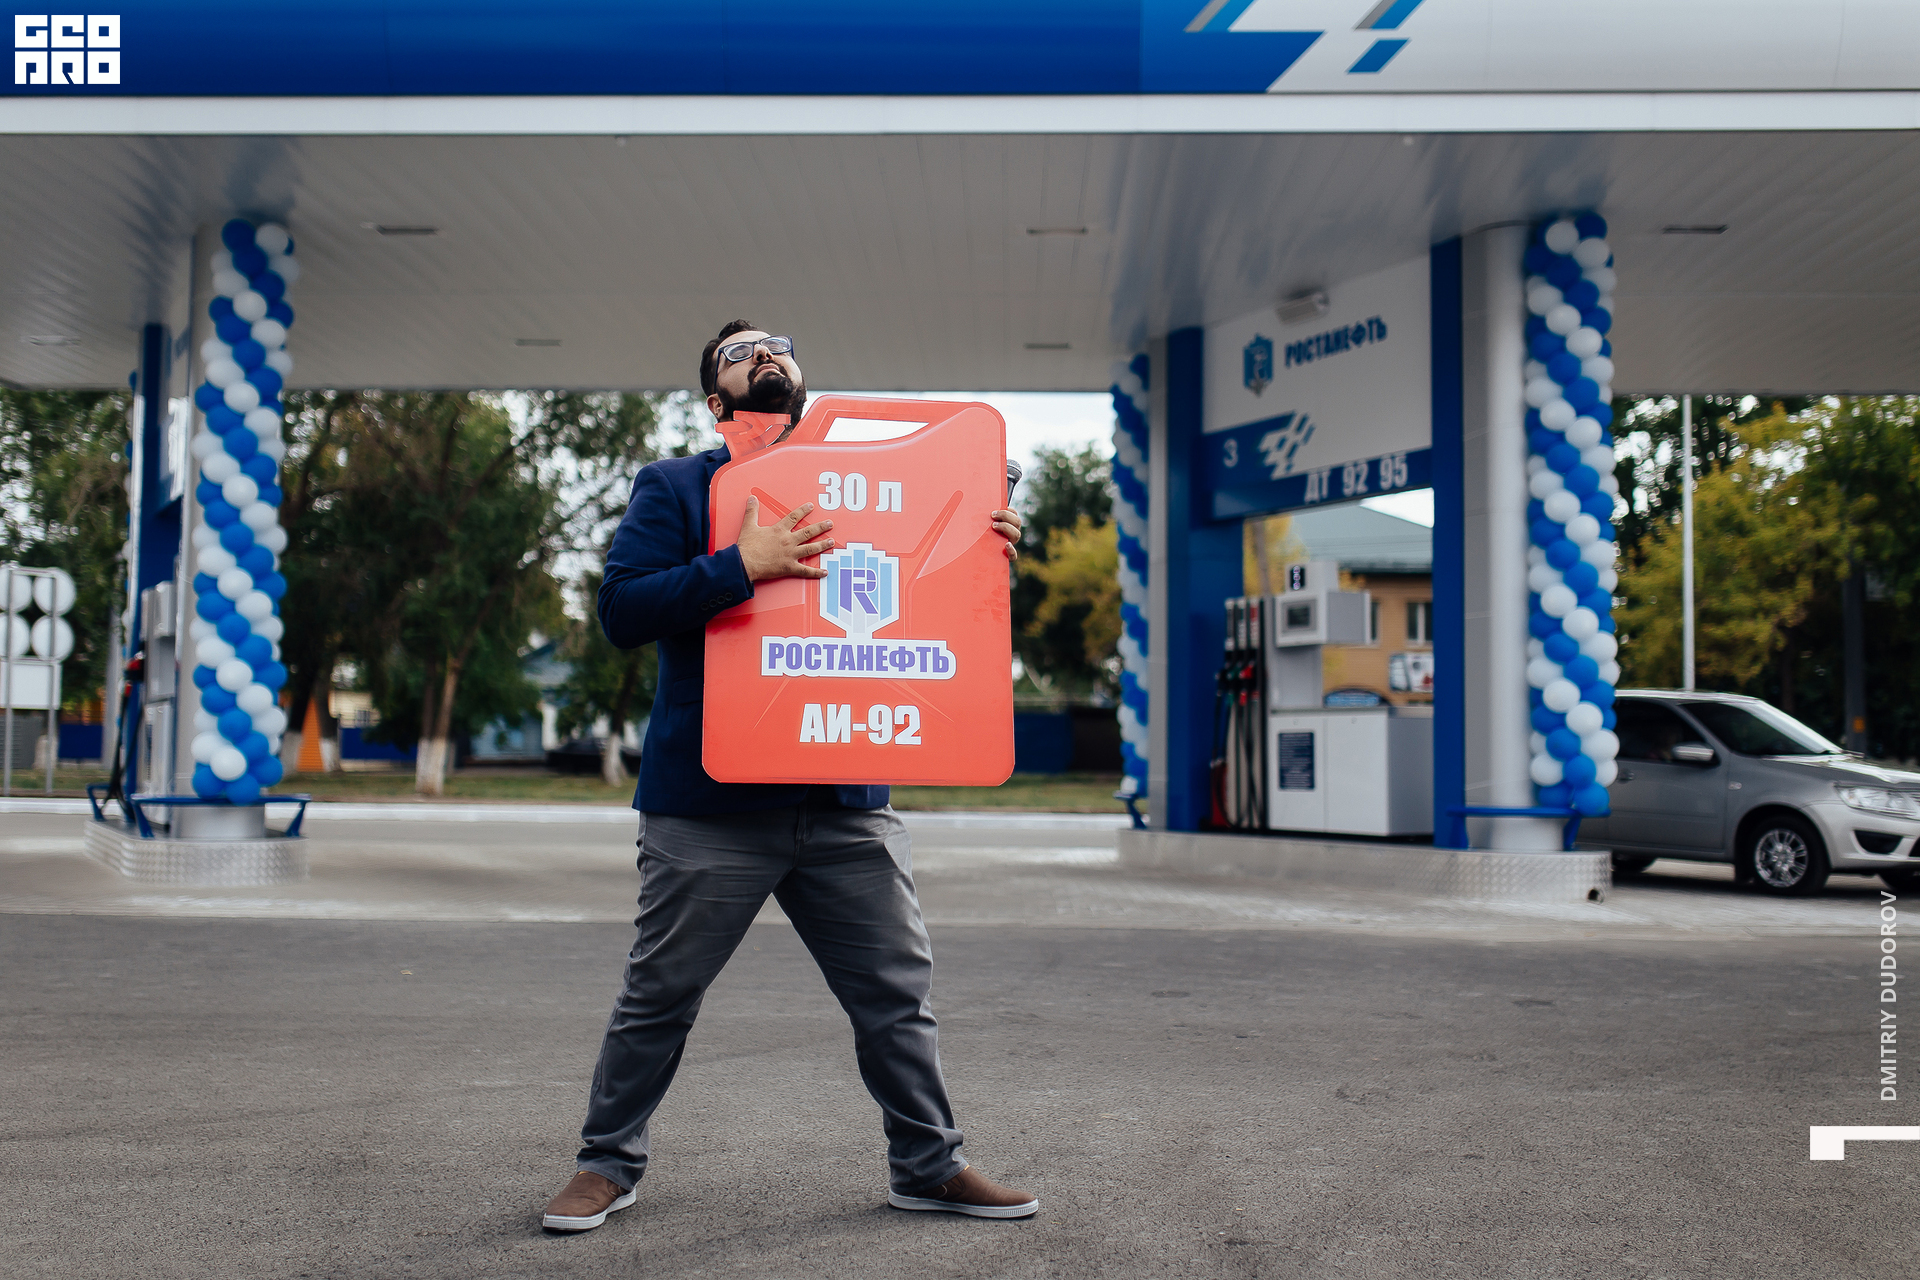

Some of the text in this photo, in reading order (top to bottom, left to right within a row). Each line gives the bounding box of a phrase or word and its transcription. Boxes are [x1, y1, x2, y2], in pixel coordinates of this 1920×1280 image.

[1285, 316, 1387, 369] РОСТАНЕФТЬ
[1223, 439, 1238, 467] 3
[818, 471, 867, 511] 30
[1304, 454, 1408, 503] ДТ 92 95
[768, 642, 950, 673] РОСТАНЕФТЬ
[800, 703, 922, 745] АИ-92
